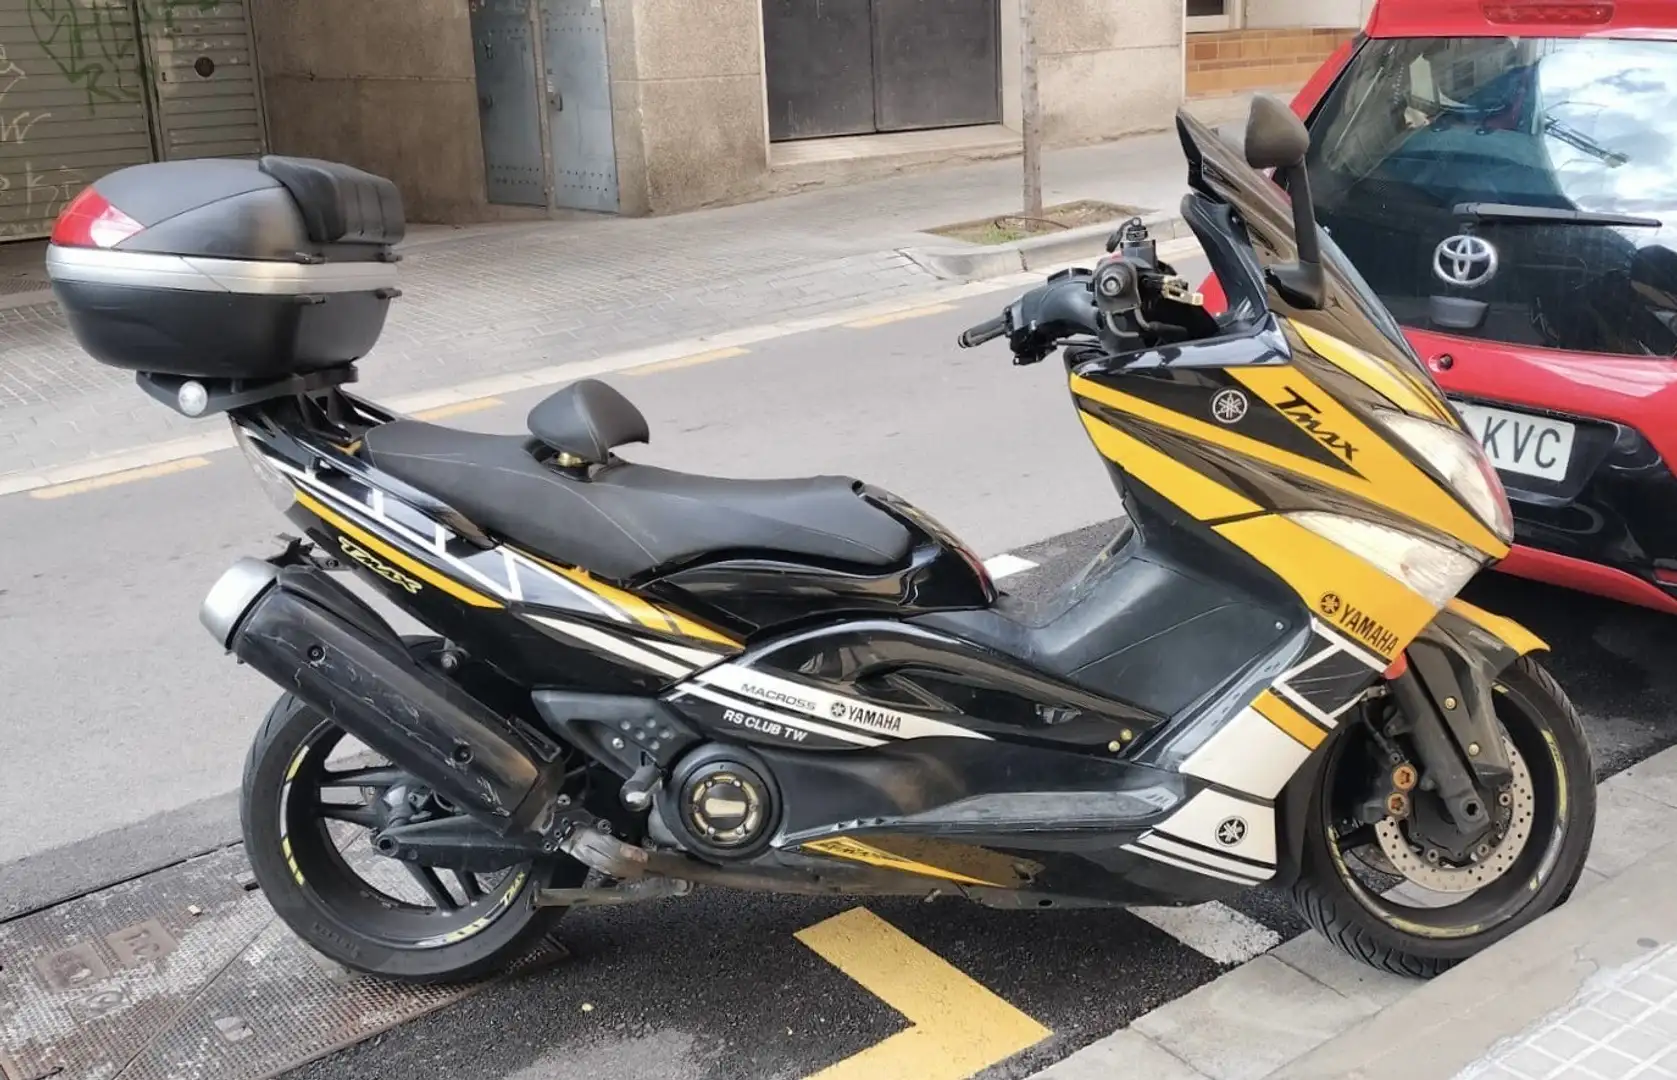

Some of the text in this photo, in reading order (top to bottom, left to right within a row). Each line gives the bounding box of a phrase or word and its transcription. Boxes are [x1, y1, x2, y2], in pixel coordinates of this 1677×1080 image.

[1482, 416, 1561, 468] KVC
[1339, 603, 1399, 656] YAMAHA
[741, 683, 817, 711] MACROSS
[723, 709, 808, 742] RS CLUB TW
[848, 705, 902, 732] YAMAHA
